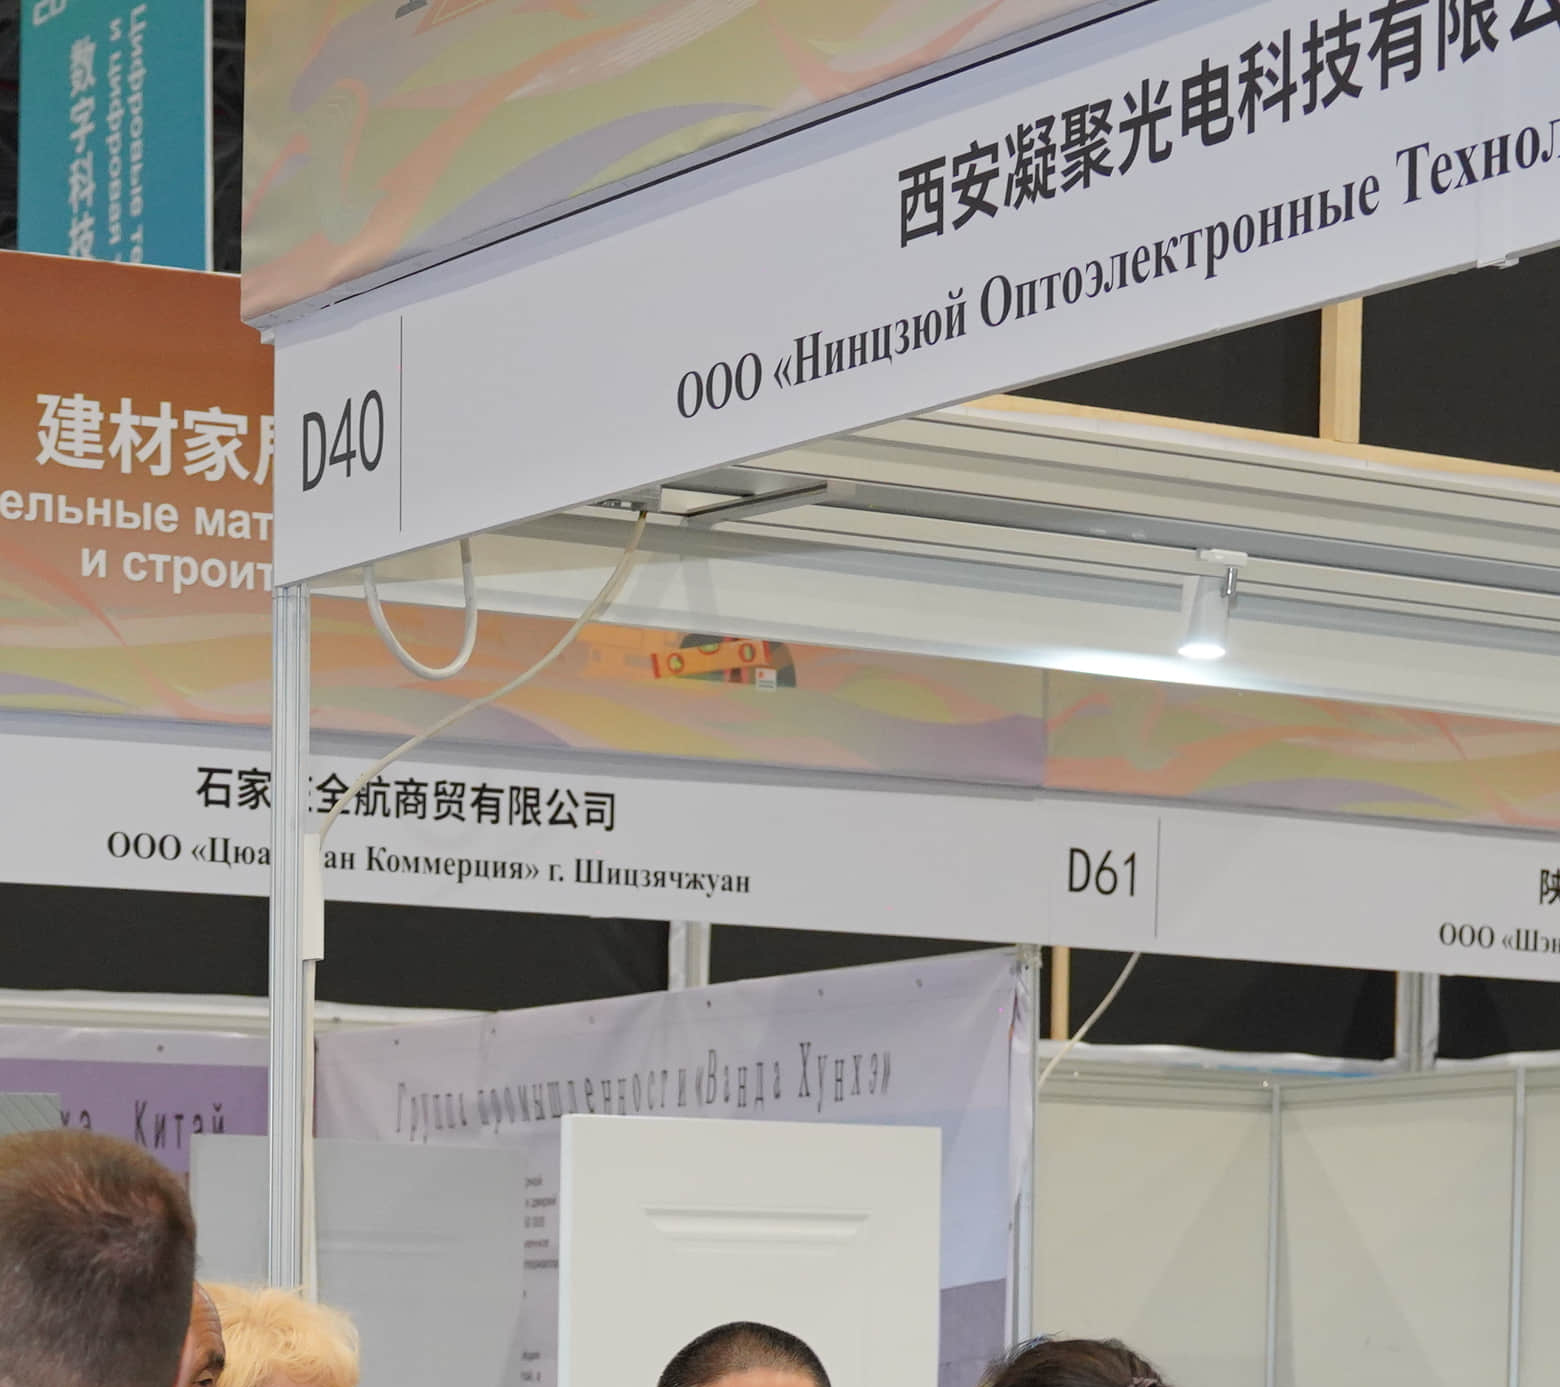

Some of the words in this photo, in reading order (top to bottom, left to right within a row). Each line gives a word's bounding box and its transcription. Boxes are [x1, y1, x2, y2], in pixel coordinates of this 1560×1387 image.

[677, 352, 762, 419] ООО
[773, 289, 967, 390] «Нинцзюй
[980, 171, 1380, 328] Оптоэлектронные
[302, 390, 384, 492] D40
[80, 546, 107, 578] и
[196, 767, 616, 833] 石家全航商贸有限公司
[107, 831, 181, 860] ООО
[366, 845, 539, 884] Коммерция»
[548, 863, 564, 883] г.
[575, 858, 752, 898] Шицзячжуан
[1067, 847, 1139, 899] D61
[1439, 922, 1495, 950] ООО
[797, 1041, 891, 1113] Хунхэ»
